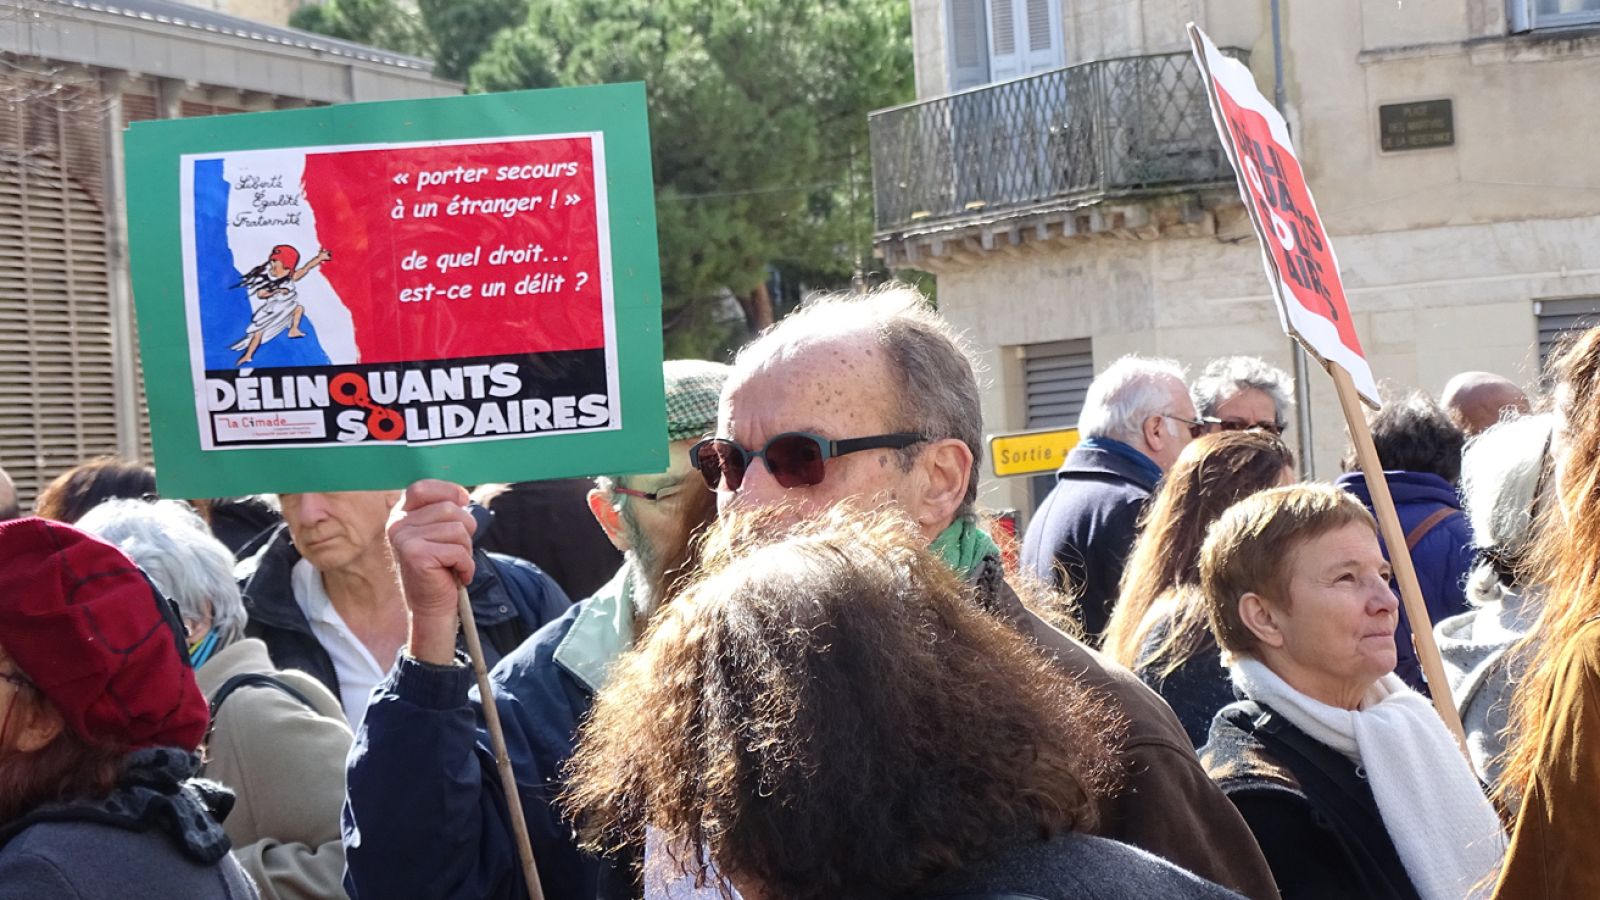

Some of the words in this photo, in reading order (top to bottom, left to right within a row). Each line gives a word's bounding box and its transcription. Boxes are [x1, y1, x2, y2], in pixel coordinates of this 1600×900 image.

[235, 174, 283, 190] Liberté
[417, 165, 488, 191] porter
[496, 162, 578, 181] secours
[252, 189, 300, 213] Égalité
[391, 199, 404, 219] à
[413, 203, 438, 218] un
[446, 195, 542, 217] étranger
[233, 211, 301, 227] Fraternité
[401, 250, 428, 271] de
[436, 246, 480, 273] quel
[400, 283, 472, 302] est-ce
[481, 281, 505, 297] un
[514, 273, 565, 295] délit
[575, 271, 589, 292] ?
[206, 362, 522, 411] DÉLINQUANTS
[241, 413, 287, 428] Cimade
[336, 393, 610, 443] SOLIDAIRES
[1001, 446, 1051, 464] Sortie
